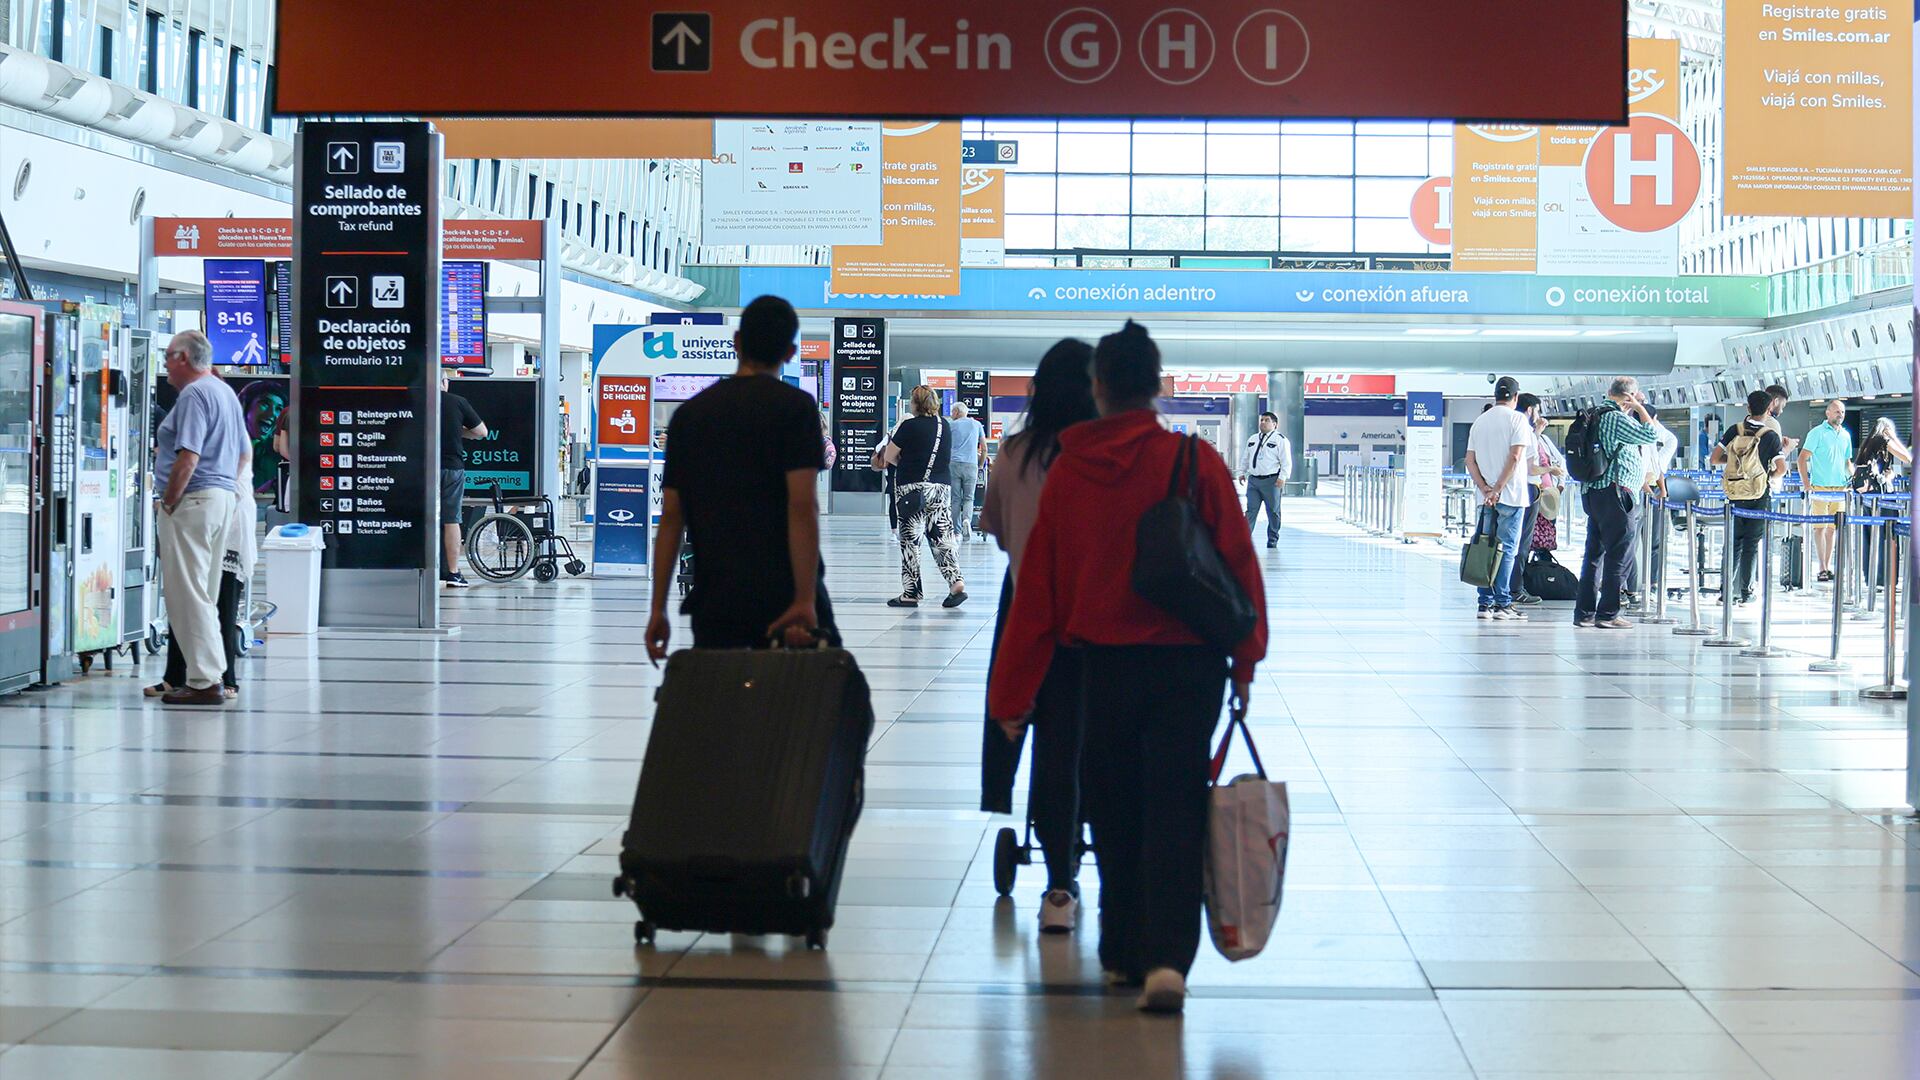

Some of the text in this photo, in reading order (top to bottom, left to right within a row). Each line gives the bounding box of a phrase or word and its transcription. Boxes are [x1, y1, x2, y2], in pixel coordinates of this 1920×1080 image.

[1762, 4, 1887, 22] Registrate gratis
[1759, 28, 1890, 43] en Smiles.com.ar
[740, 16, 1277, 70] Check-in G H I
[1763, 69, 1885, 87] Viajá con millas,
[1761, 92, 1887, 109] viajá con Smiles.
[1550, 136, 1577, 144] todas
[909, 162, 937, 172] gratis
[1613, 134, 1673, 205] H
[325, 185, 407, 199] Sellado de
[309, 201, 421, 219] comprobantes
[884, 202, 935, 213] con millas,
[1543, 203, 1565, 212] GOL
[338, 220, 393, 231] Tax refund
[901, 216, 936, 226] Smiles.
[1055, 283, 1216, 301] conexión adentro
[1322, 285, 1469, 303] conexión afuera
[1573, 284, 1709, 304] conexión total
[217, 311, 254, 326] 8-16
[319, 319, 411, 333] Declaración
[323, 336, 406, 353] de objetos
[682, 336, 734, 348] univers
[843, 341, 876, 349] Sellado de
[682, 347, 736, 359] assistan
[837, 348, 881, 356] comprobantes
[325, 355, 403, 365] Formulario 121
[603, 384, 646, 393] ESTACIÓN
[615, 393, 646, 401] HIGIENE
[851, 401, 875, 409] objetos
[357, 411, 397, 420] Reintegro
[357, 432, 385, 441] Capilla
[472, 449, 519, 465] gusta
[357, 476, 394, 484] Cafetería
[357, 498, 382, 506] Baños
[381, 520, 412, 529] pasajes
